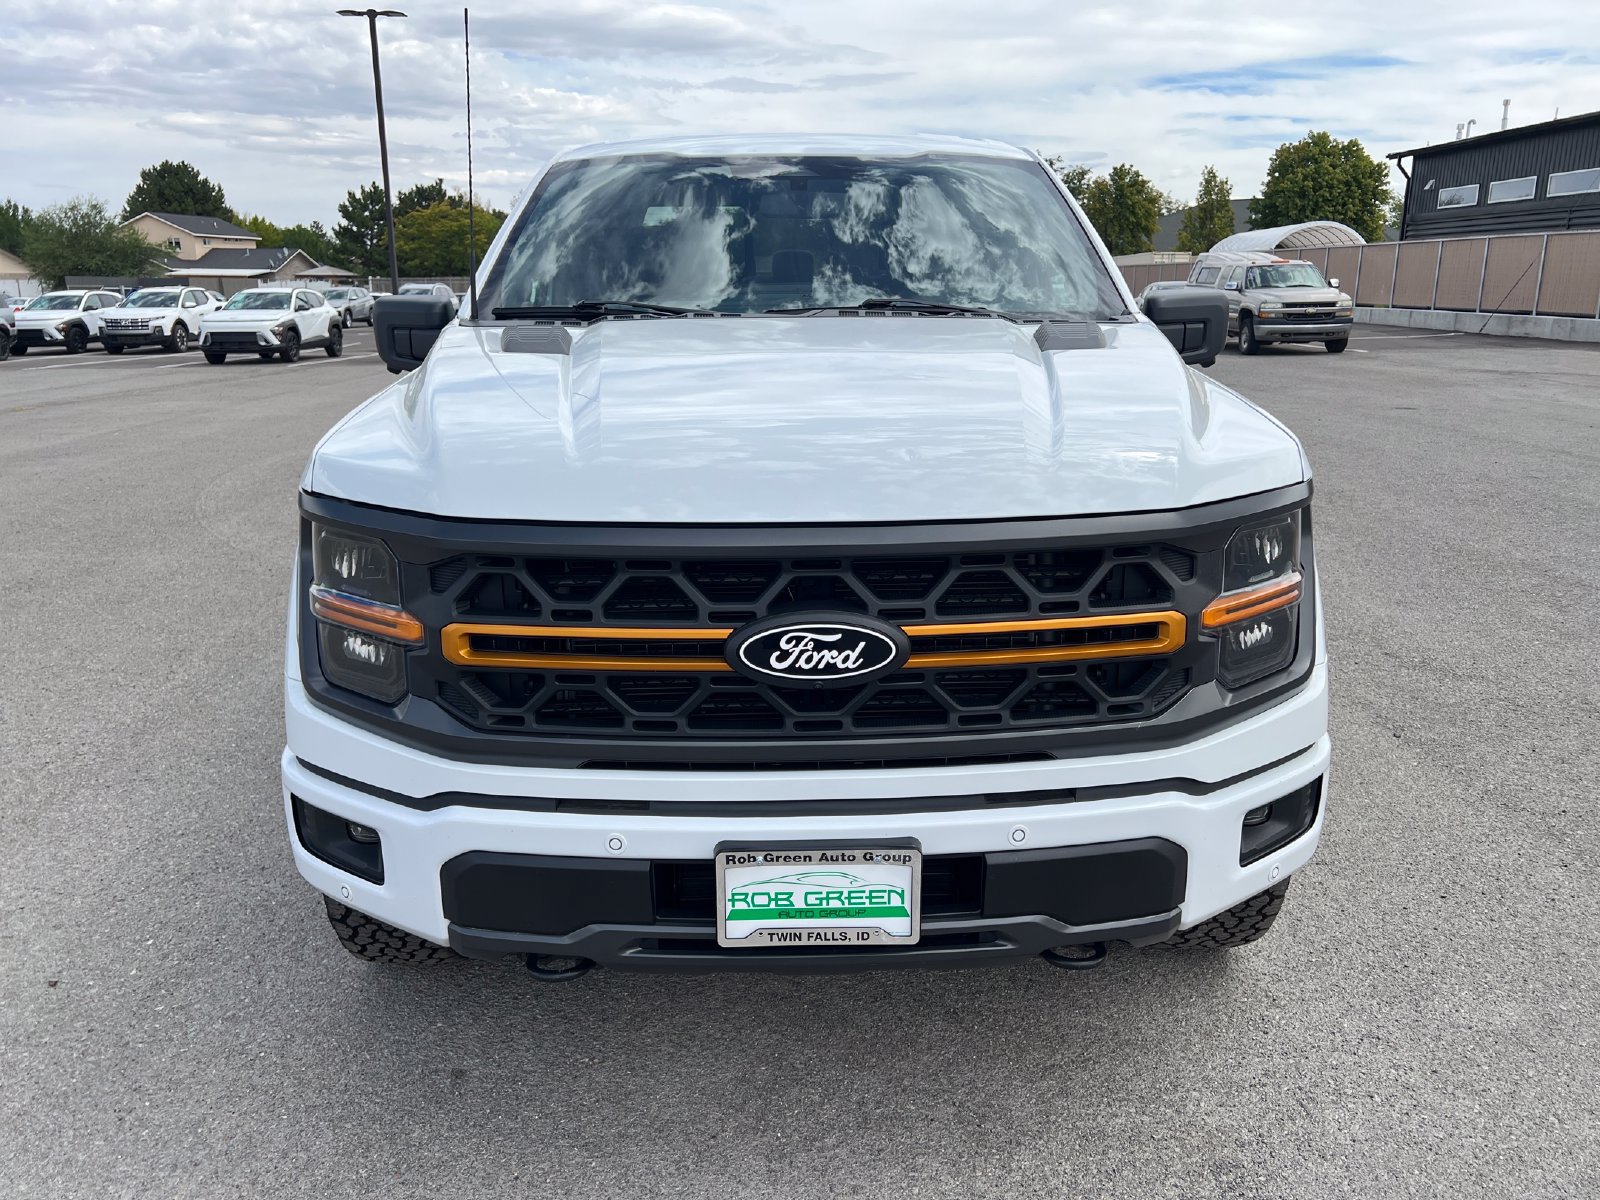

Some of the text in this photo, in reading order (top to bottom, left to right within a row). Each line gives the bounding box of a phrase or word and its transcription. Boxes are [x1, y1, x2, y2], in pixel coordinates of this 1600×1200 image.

[769, 632, 865, 670] Ford
[725, 853, 756, 865] Rob
[763, 853, 812, 863] Green
[818, 852, 857, 862] Auto
[728, 890, 905, 908] ROB GREEN
[777, 909, 866, 919] AUTO GROUP
[767, 931, 870, 942] TWIN FALLS, ID
